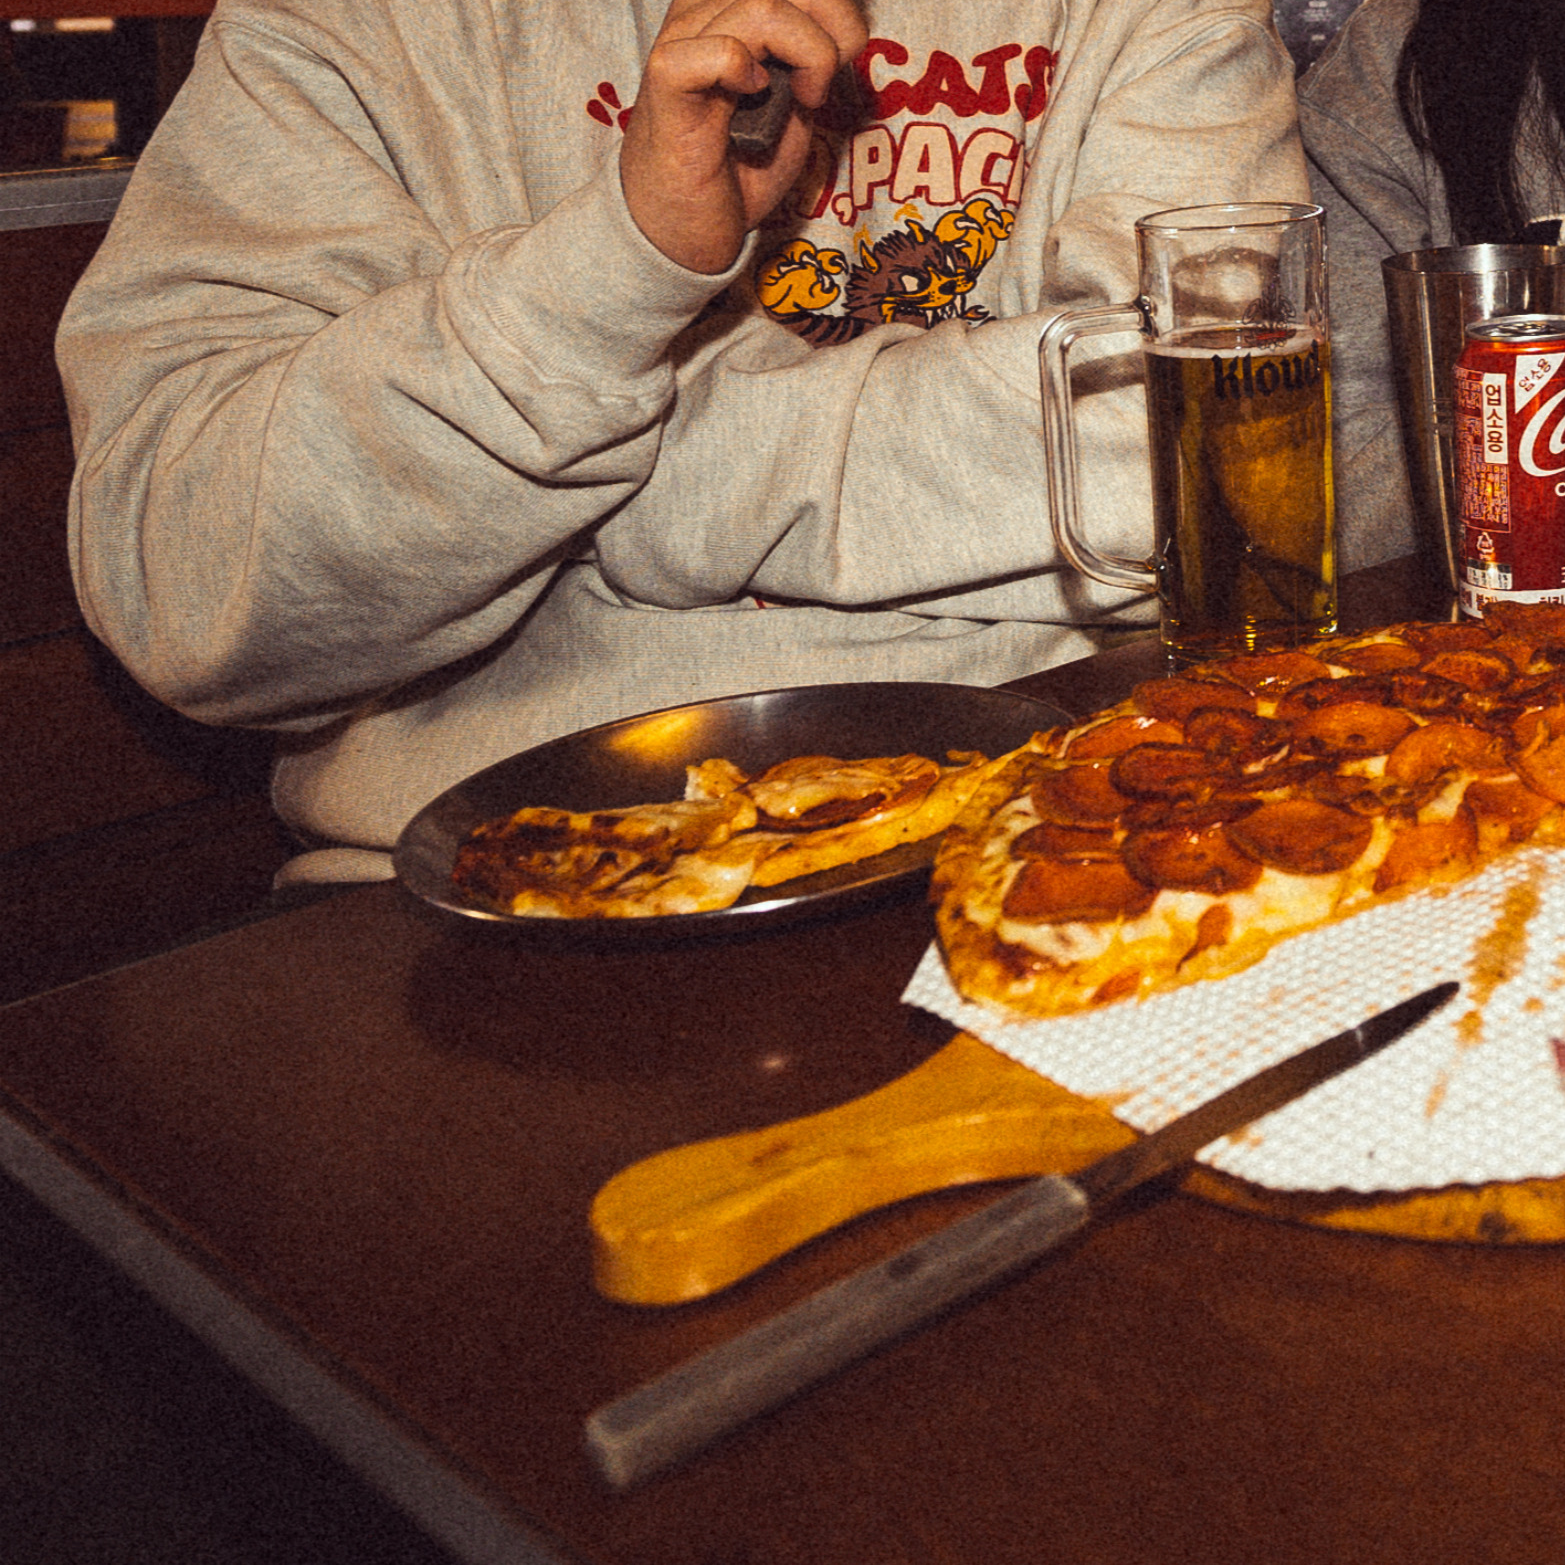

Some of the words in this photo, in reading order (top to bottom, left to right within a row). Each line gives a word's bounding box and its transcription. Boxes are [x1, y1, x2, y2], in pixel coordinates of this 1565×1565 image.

[815, 37, 1059, 127] CATS
[1518, 358, 1552, 393] 업소용
[1484, 383, 1504, 454] 업소용
